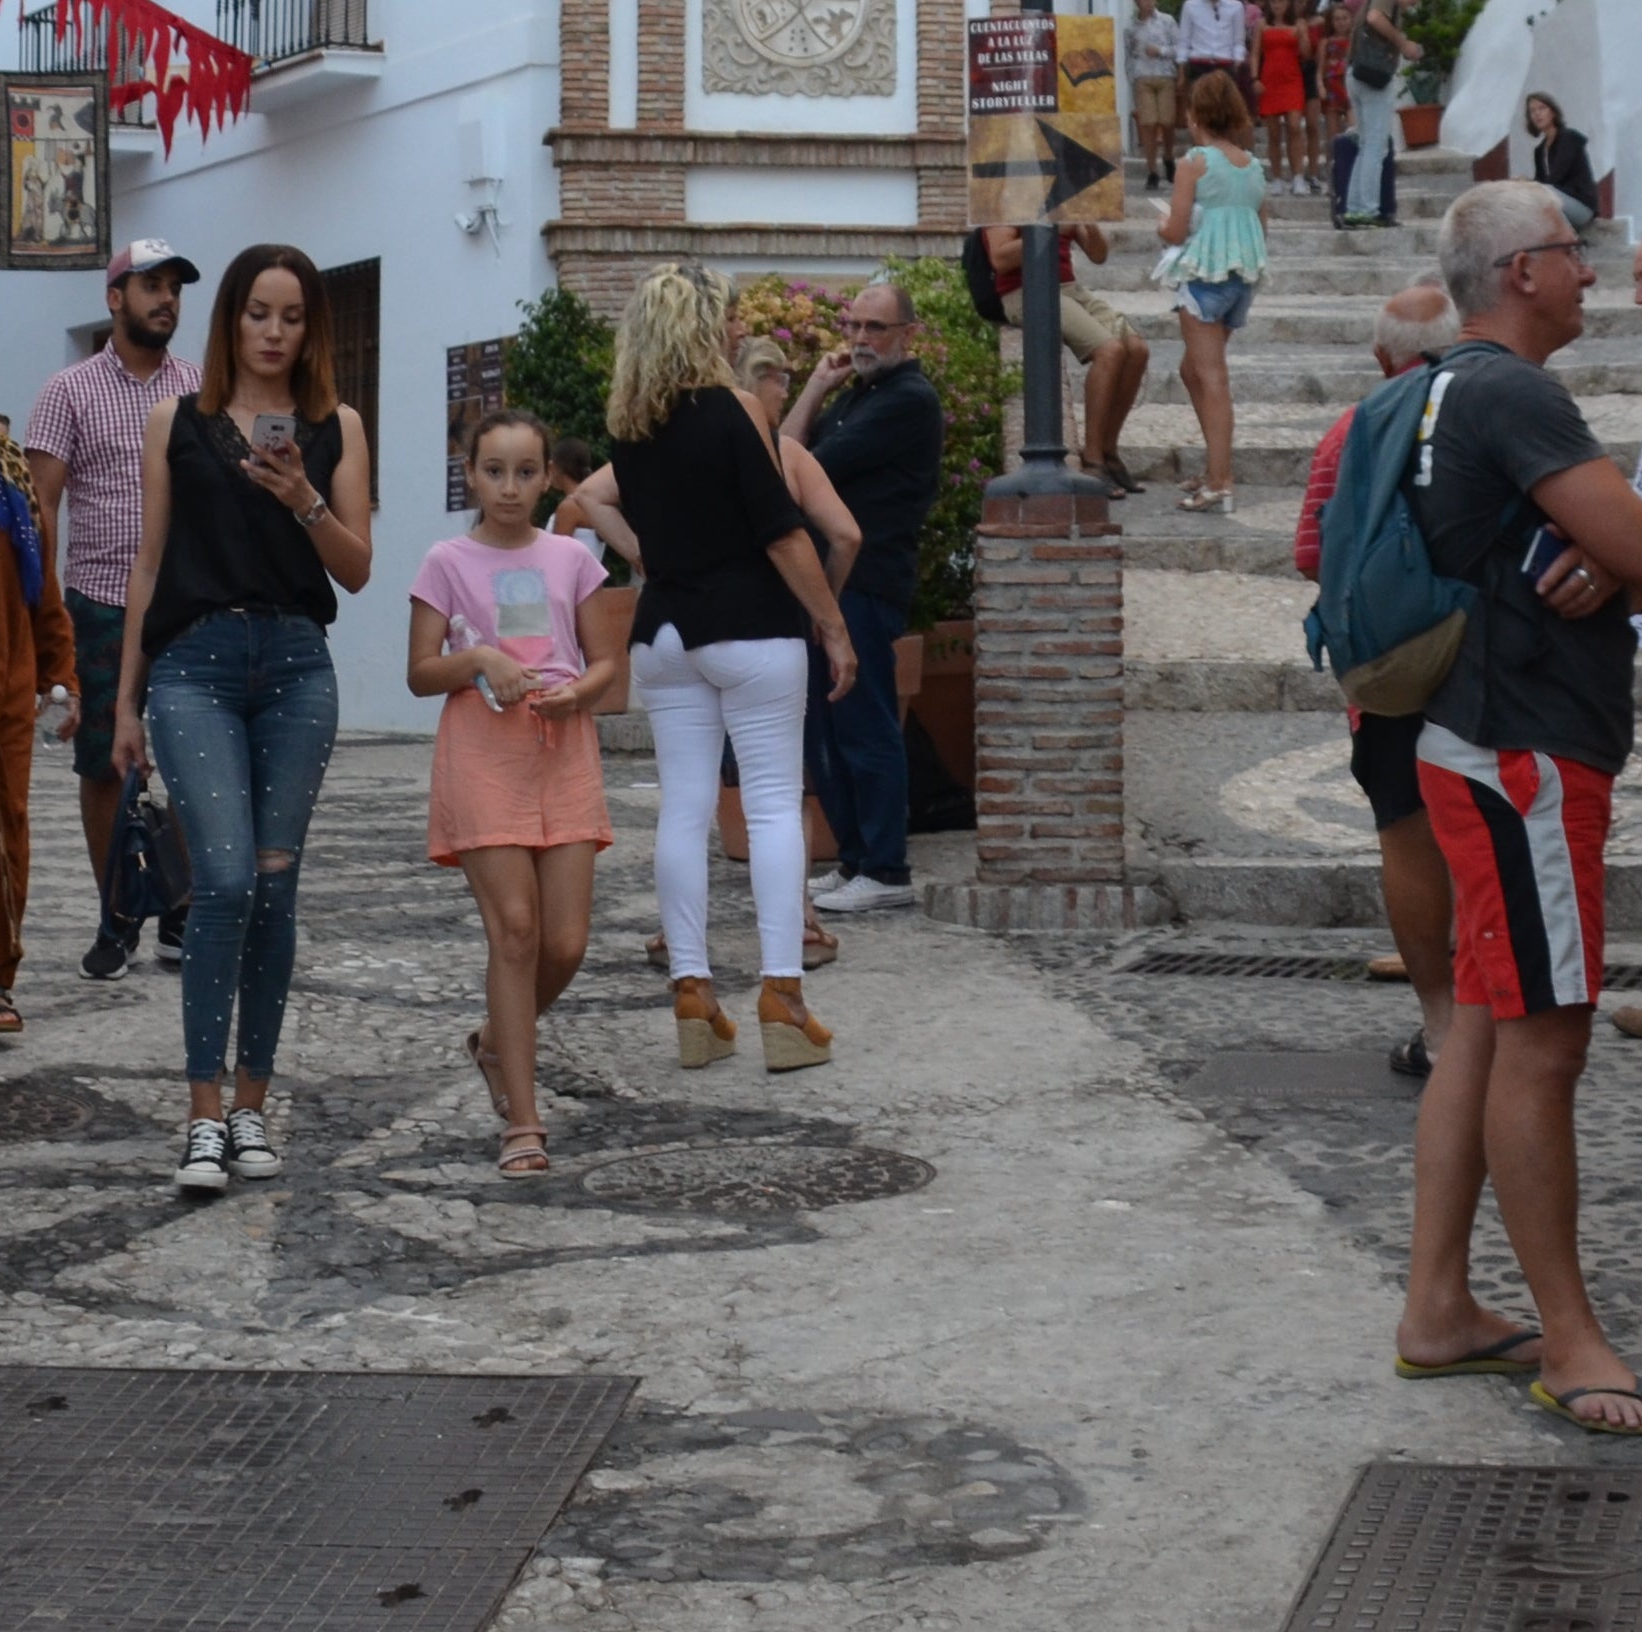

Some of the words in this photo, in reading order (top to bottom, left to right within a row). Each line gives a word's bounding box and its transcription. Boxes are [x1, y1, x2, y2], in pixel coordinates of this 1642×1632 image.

[988, 37, 995, 48] A
[998, 36, 1011, 47] LA
[1013, 35, 1033, 46] LUZ
[977, 52, 991, 65] DE
[994, 51, 1014, 63] LAS
[1017, 50, 1049, 62] VELAS
[991, 79, 1028, 93] NIGHT
[971, 95, 1055, 109] STORYTELLER
